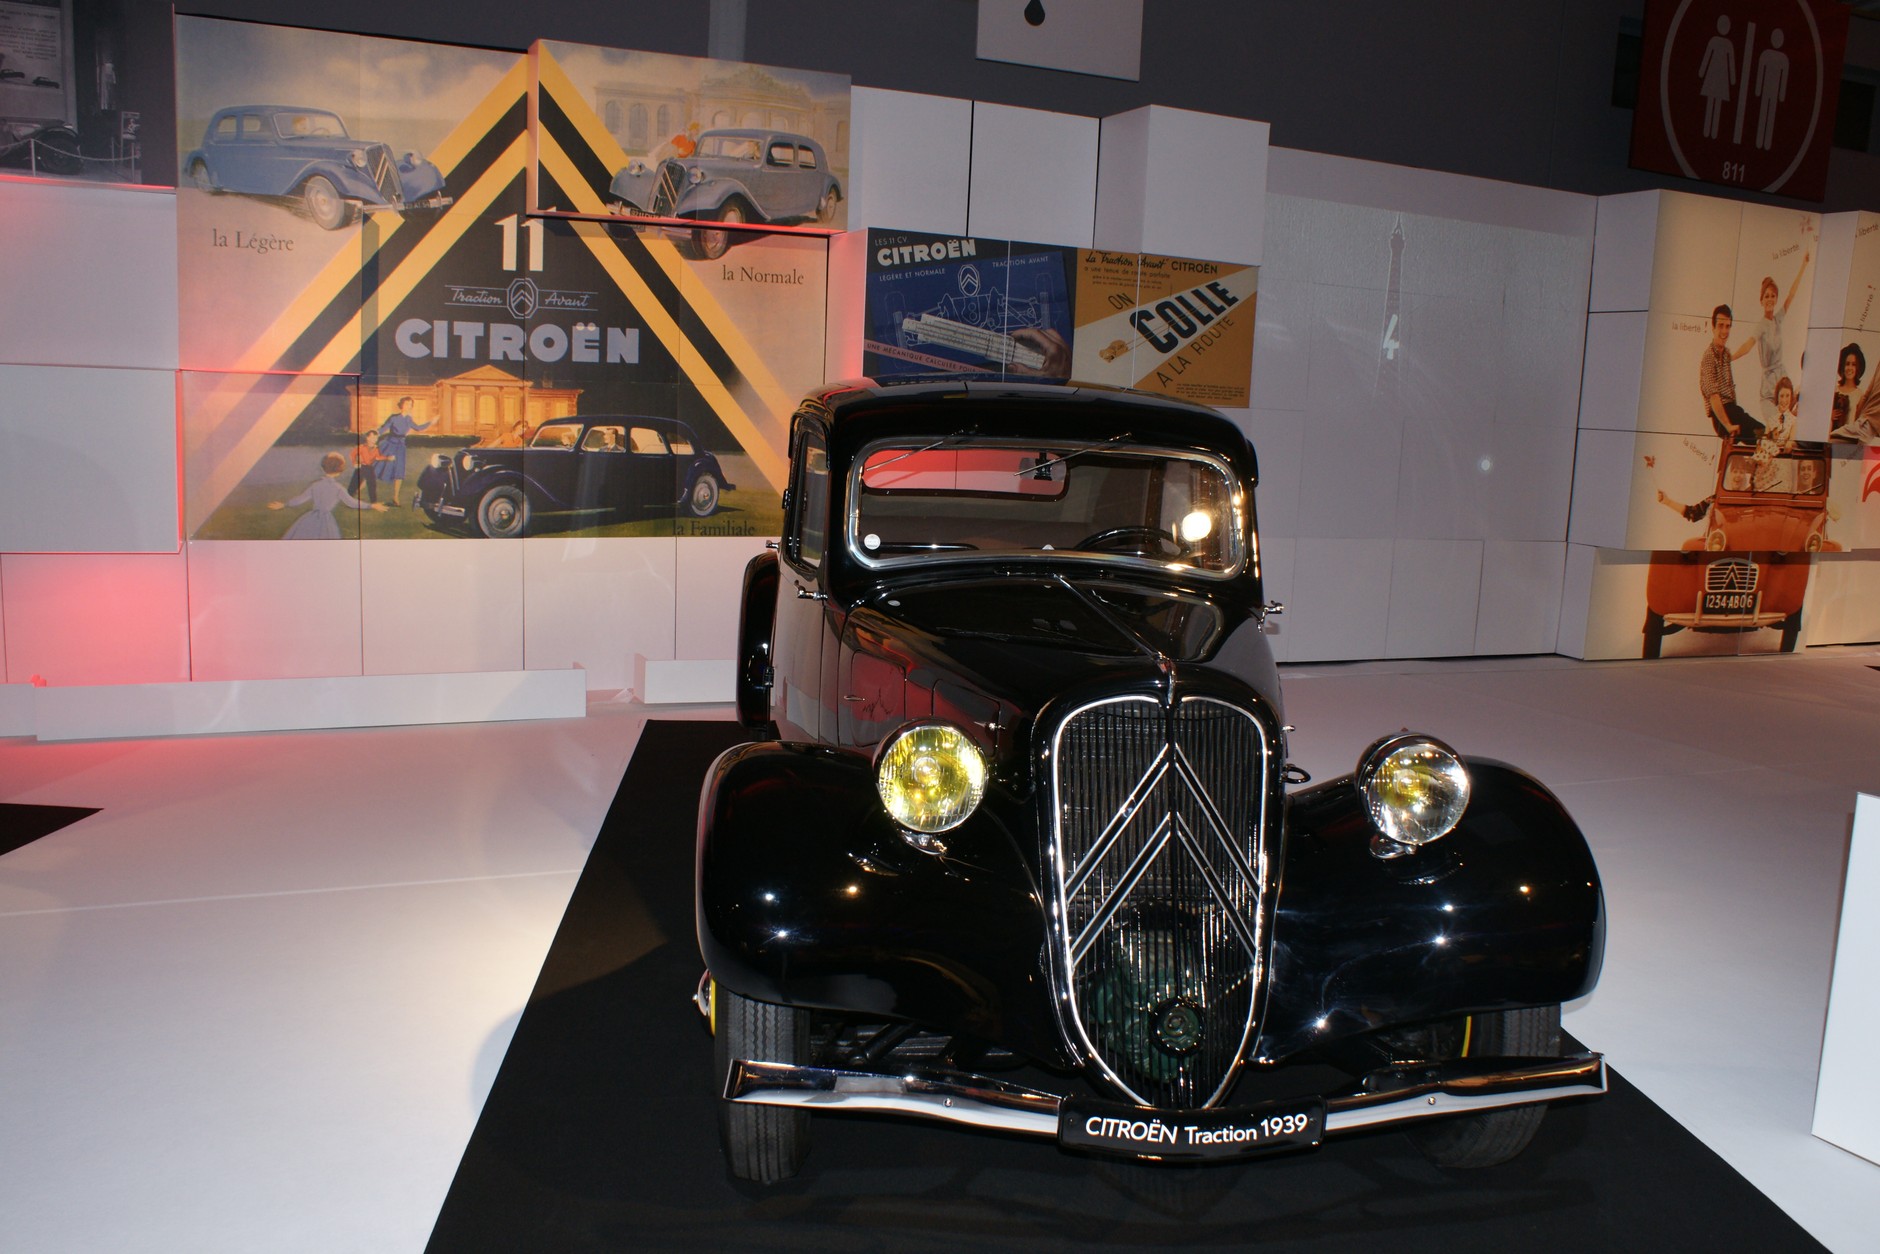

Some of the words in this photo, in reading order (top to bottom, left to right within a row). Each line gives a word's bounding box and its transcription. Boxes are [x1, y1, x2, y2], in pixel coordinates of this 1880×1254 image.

[1722, 161, 1746, 183] 811
[213, 228, 228, 247] la
[236, 231, 294, 255] Légère
[495, 213, 545, 272] 11
[874, 239, 888, 247] LES
[897, 236, 908, 244] CV
[877, 239, 977, 267] CITROËN
[992, 259, 1026, 268] TRACTION
[1028, 256, 1049, 264] AVANT
[723, 264, 735, 281] la
[740, 266, 805, 285] Normale
[879, 273, 904, 282] LÉGÈRE
[905, 271, 913, 279] ET
[914, 268, 946, 277] NORMALE
[1171, 261, 1218, 274] CITROËN
[450, 287, 504, 305] Traction
[544, 292, 590, 308] Avant
[1108, 292, 1136, 310] ON
[1129, 281, 1240, 354] COLLE
[395, 317, 640, 364] CITROËN
[867, 343, 881, 351] UNE
[1156, 370, 1174, 389] A
[1168, 355, 1193, 376] LA
[1190, 315, 1236, 356] ROUTE
[672, 519, 684, 536] la
[690, 520, 755, 536] Familiale
[1085, 1116, 1178, 1144] CITROËN
[1184, 1125, 1257, 1145] Traction
[1260, 1113, 1308, 1137] 1939
